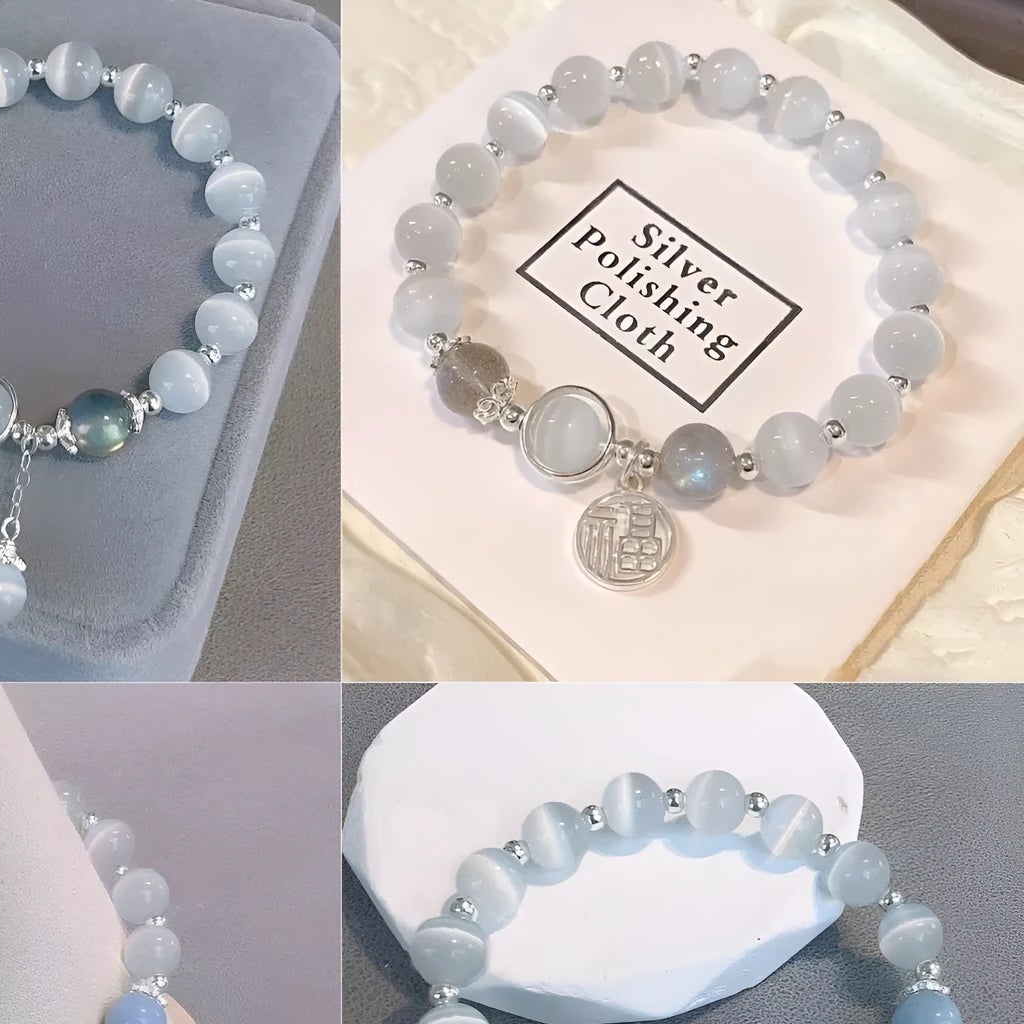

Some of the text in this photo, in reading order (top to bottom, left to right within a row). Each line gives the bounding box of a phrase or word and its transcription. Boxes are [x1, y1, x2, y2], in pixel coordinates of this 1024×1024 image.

[570, 225, 739, 361] Polishing
[631, 223, 738, 306] Silver
[579, 280, 675, 364] Cloth
